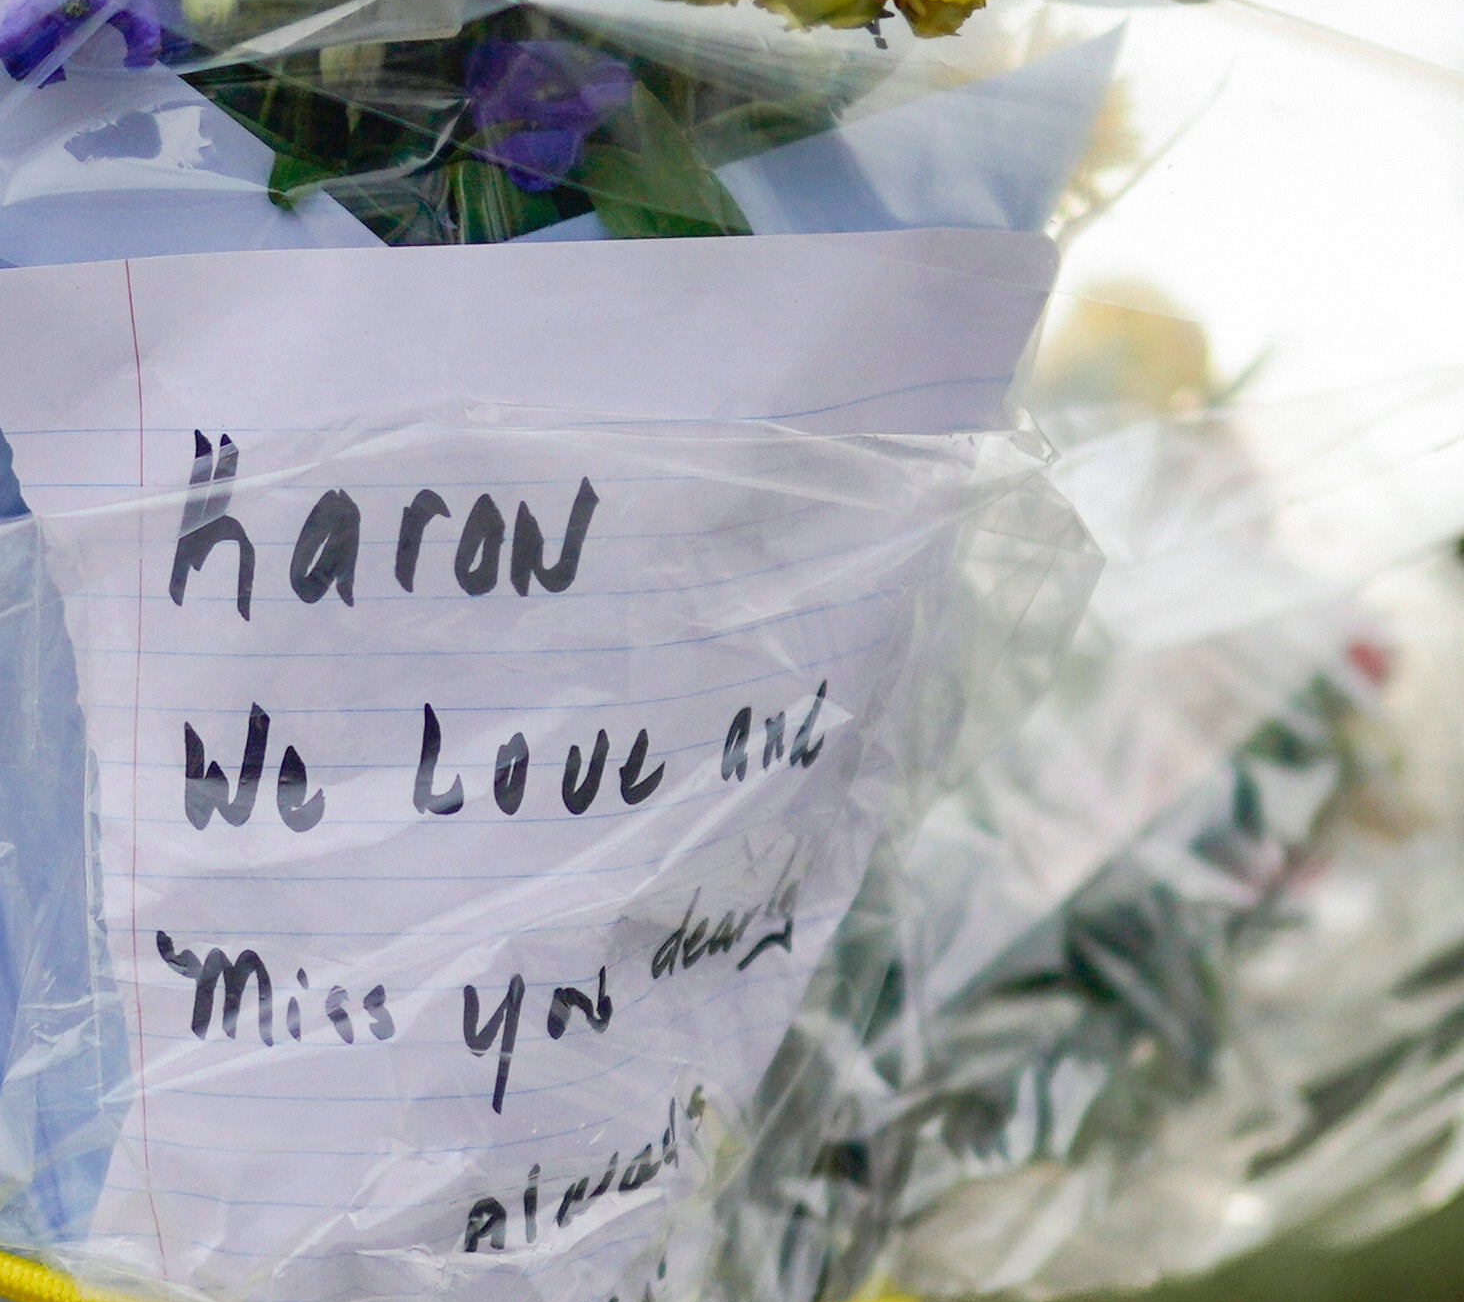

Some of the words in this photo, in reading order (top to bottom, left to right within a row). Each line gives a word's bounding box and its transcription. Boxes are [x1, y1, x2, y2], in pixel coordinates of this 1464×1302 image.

[184, 701, 326, 832] We
[412, 702, 665, 816] Love
[720, 678, 828, 783] and
[155, 930, 397, 1047] Miss
